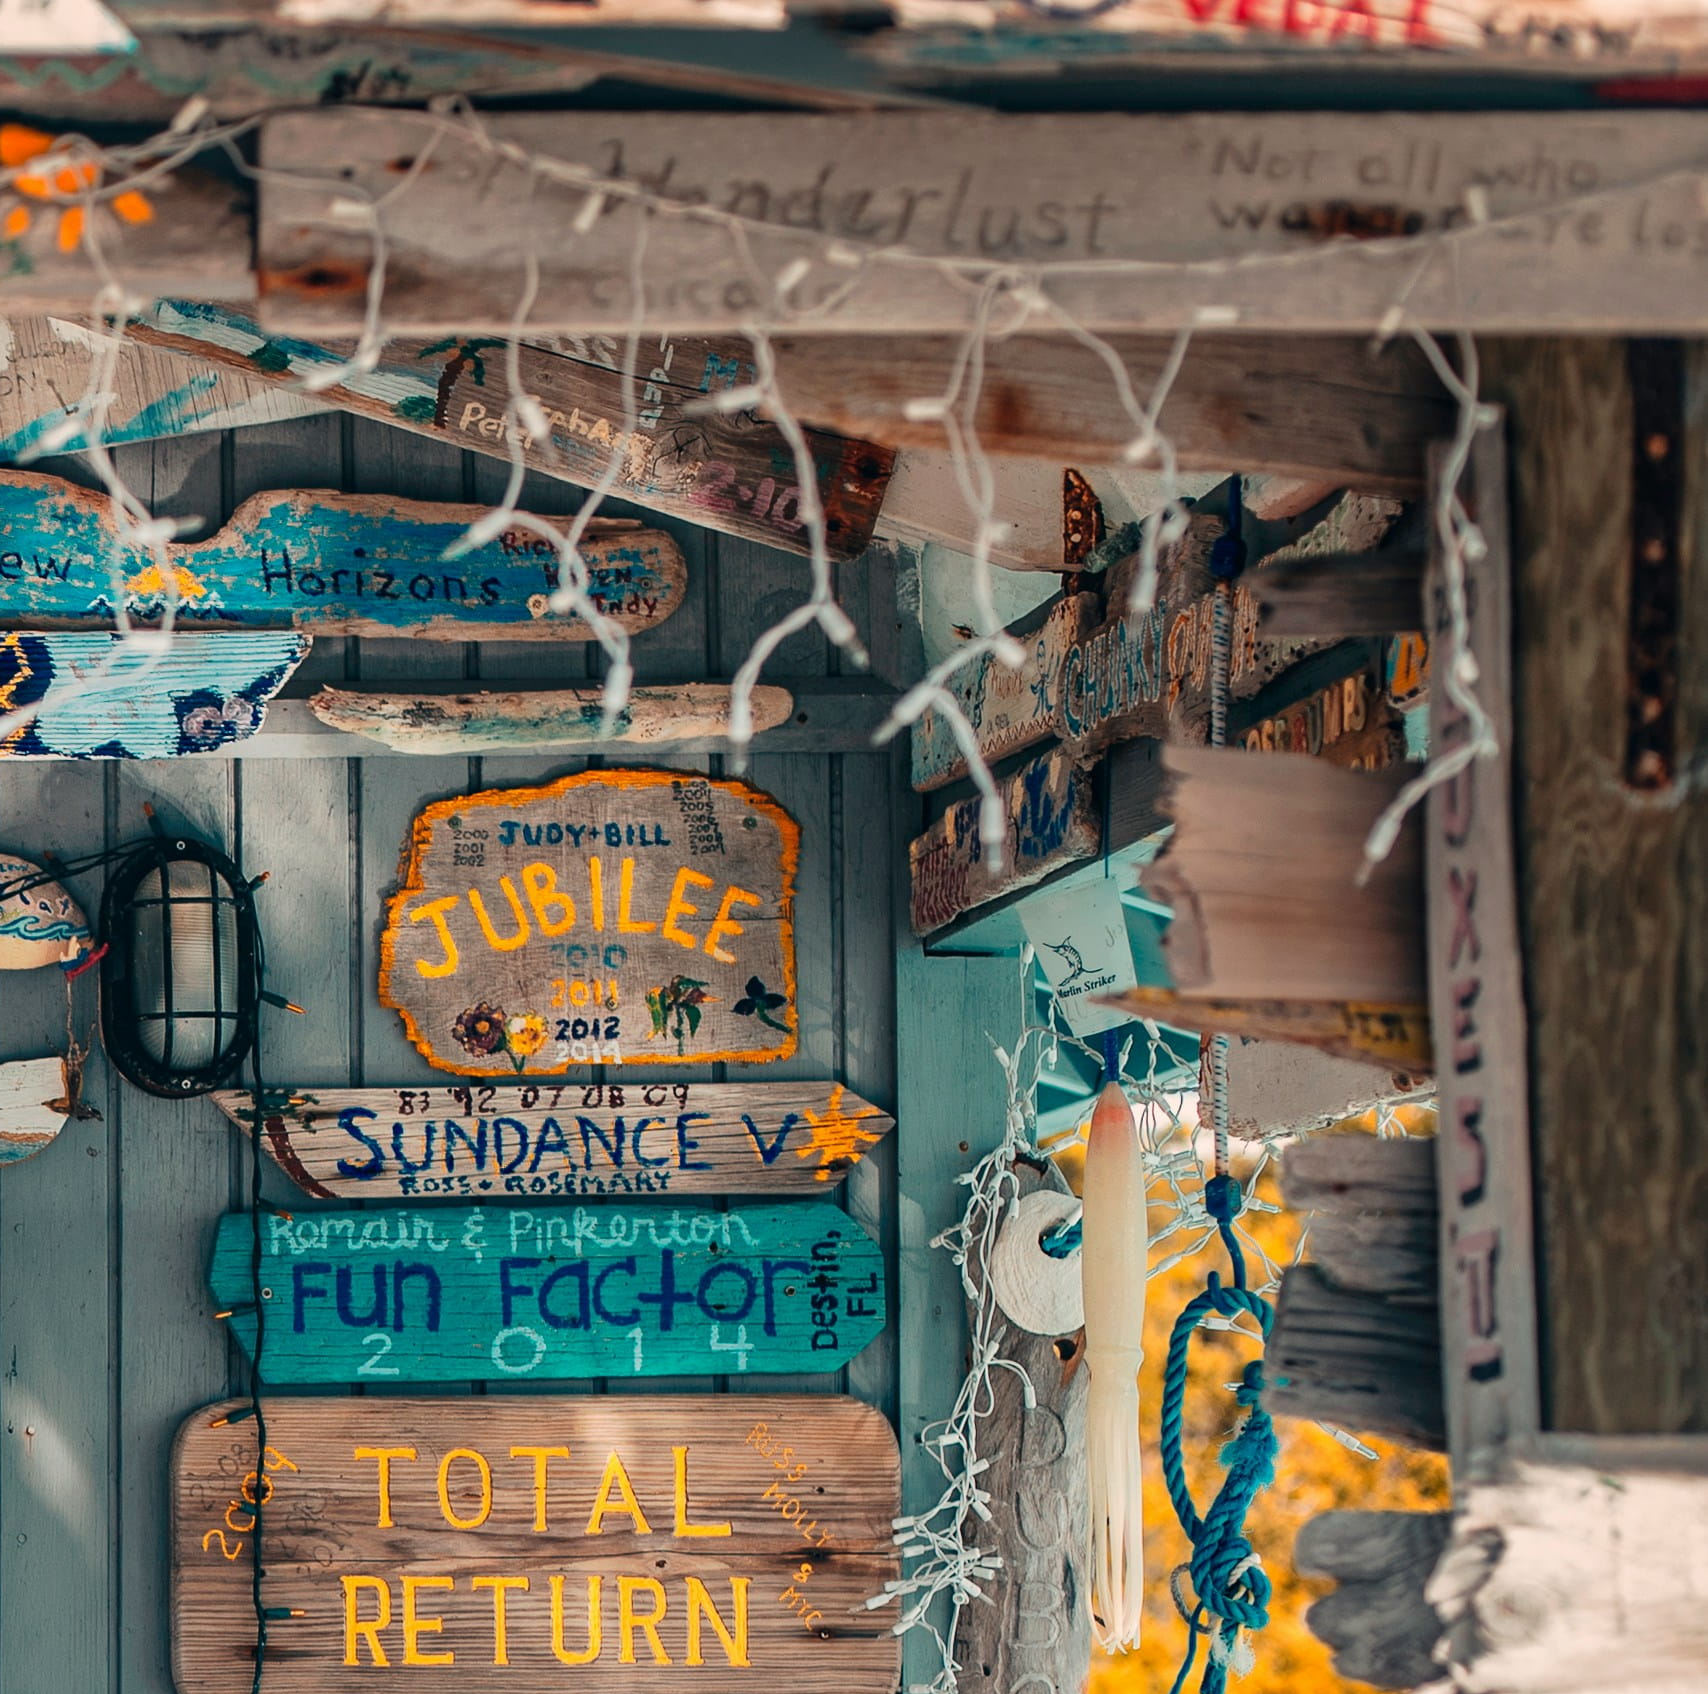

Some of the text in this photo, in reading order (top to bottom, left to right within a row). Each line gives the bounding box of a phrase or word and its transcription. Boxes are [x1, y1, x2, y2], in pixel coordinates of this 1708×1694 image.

[260, 545, 504, 611] Horizons
[409, 855, 762, 979] JUBILEE
[1082, 971, 1117, 993] Striker
[554, 1016, 621, 1041] 2012
[336, 1107, 797, 1181] SUNDANCE V
[505, 1171, 674, 1195] ROSEMARY
[508, 1206, 760, 1257] Pinkerton
[745, 1422, 810, 1483] RUSS
[352, 1444, 733, 1539] TOTAL
[759, 1478, 835, 1548] MOLLY
[340, 1573, 752, 1668] RETURN
